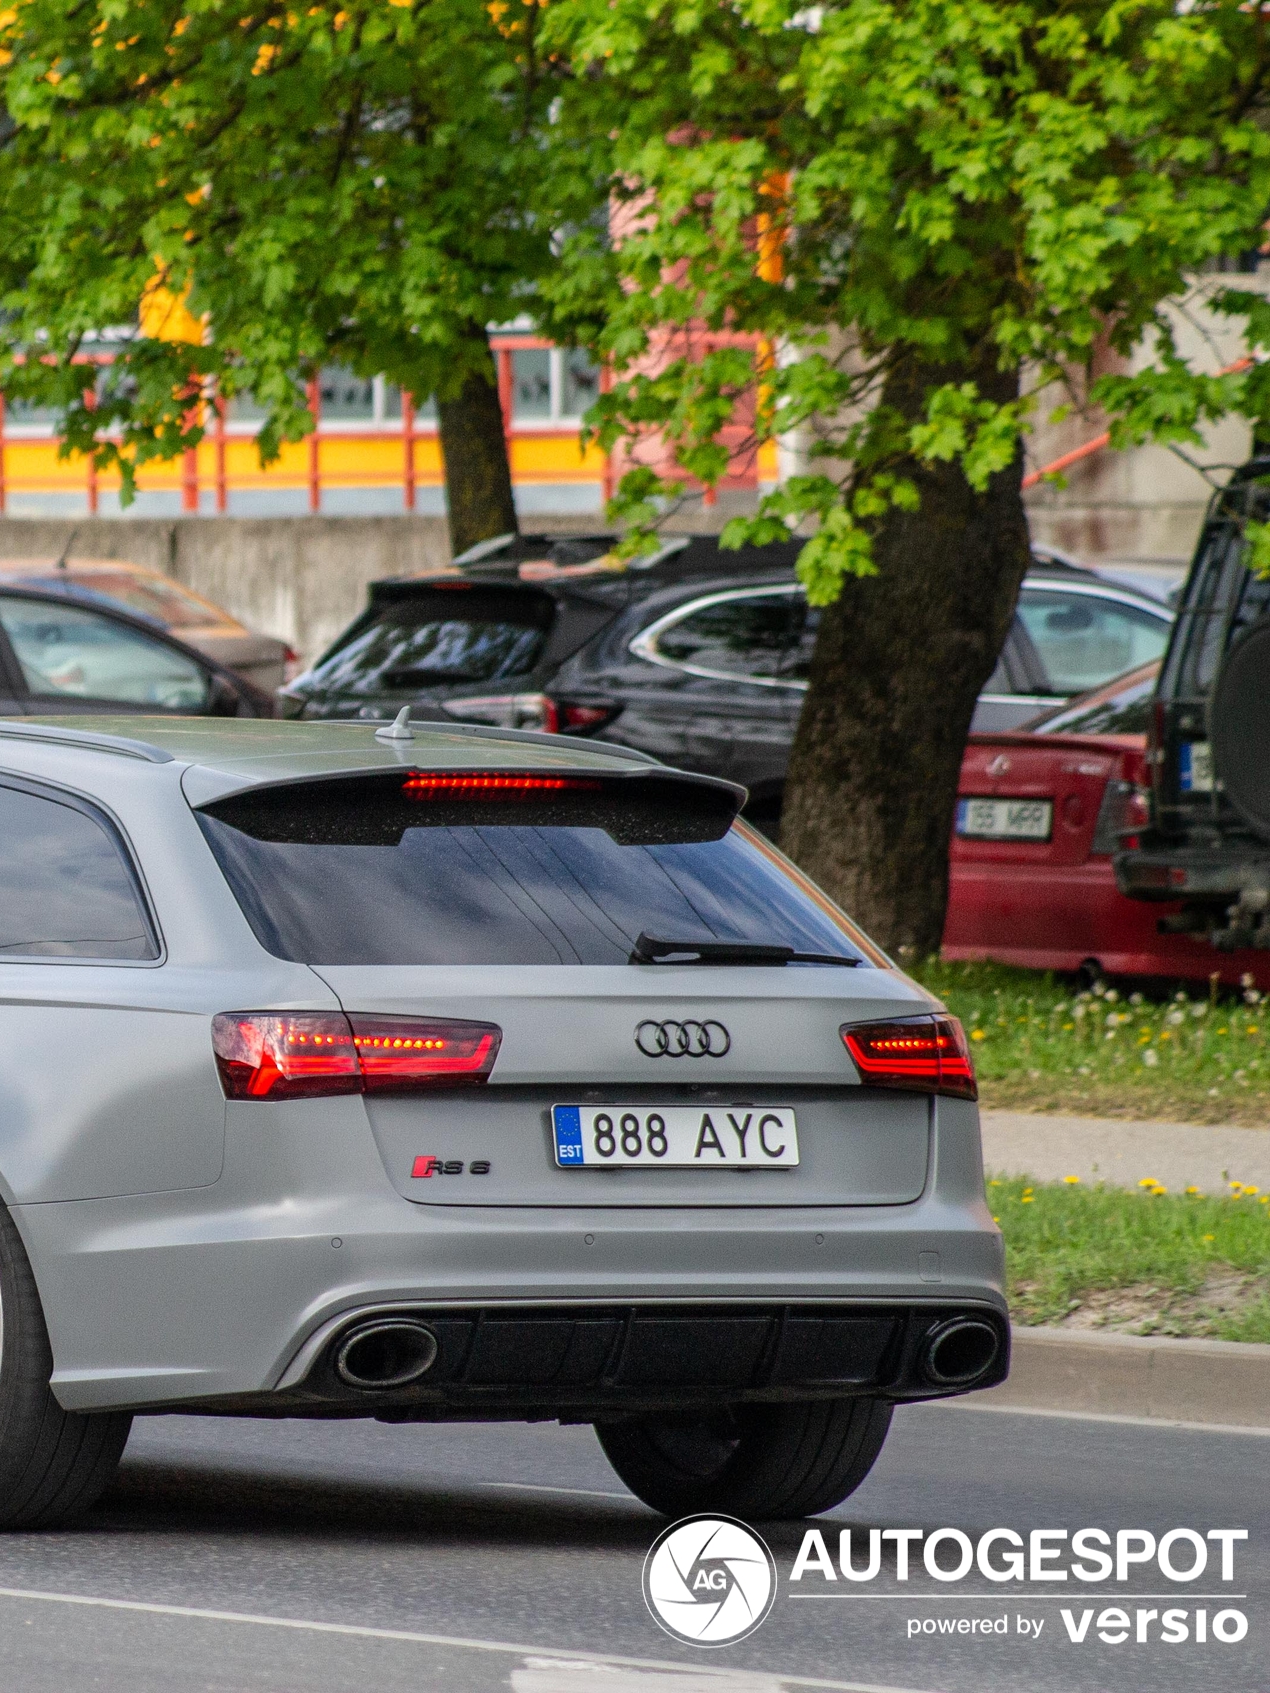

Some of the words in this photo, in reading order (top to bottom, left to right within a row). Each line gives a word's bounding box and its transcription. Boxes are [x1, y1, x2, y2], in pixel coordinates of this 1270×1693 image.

[592, 1112, 669, 1158] 888
[693, 1112, 786, 1159] AYC
[559, 1144, 582, 1158] EST
[423, 1159, 464, 1175] RS
[469, 1159, 491, 1175] 6
